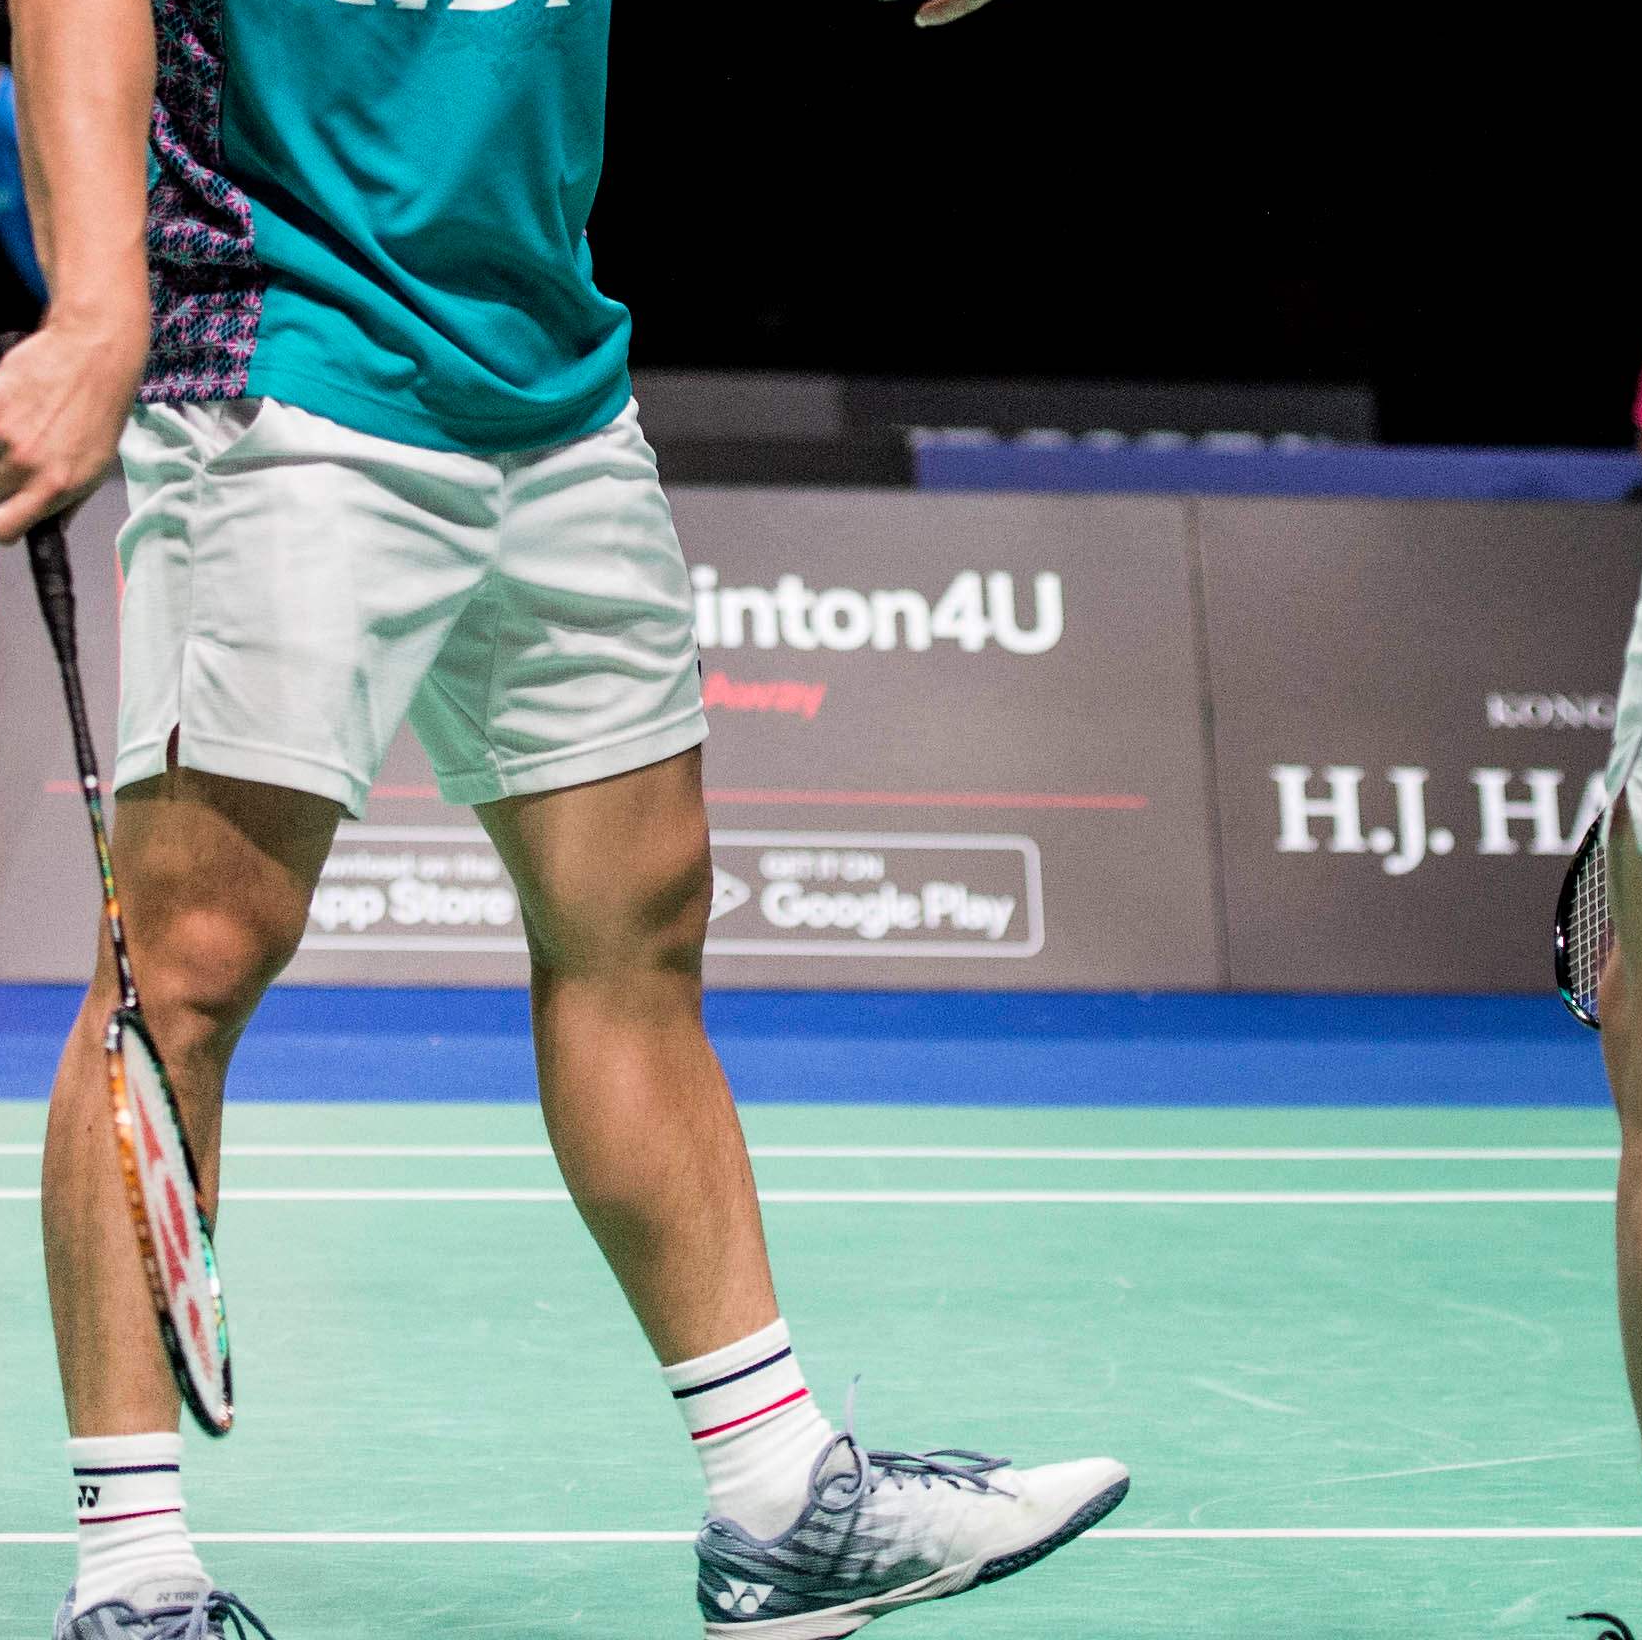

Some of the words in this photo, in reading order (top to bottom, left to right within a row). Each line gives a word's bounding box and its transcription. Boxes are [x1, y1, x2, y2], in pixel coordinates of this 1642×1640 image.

[691, 565, 1065, 656] inton4U
[1269, 763, 1456, 876] H.J.
[388, 877, 516, 926] Store
[759, 881, 922, 940] Google
[922, 881, 1016, 940] Play
